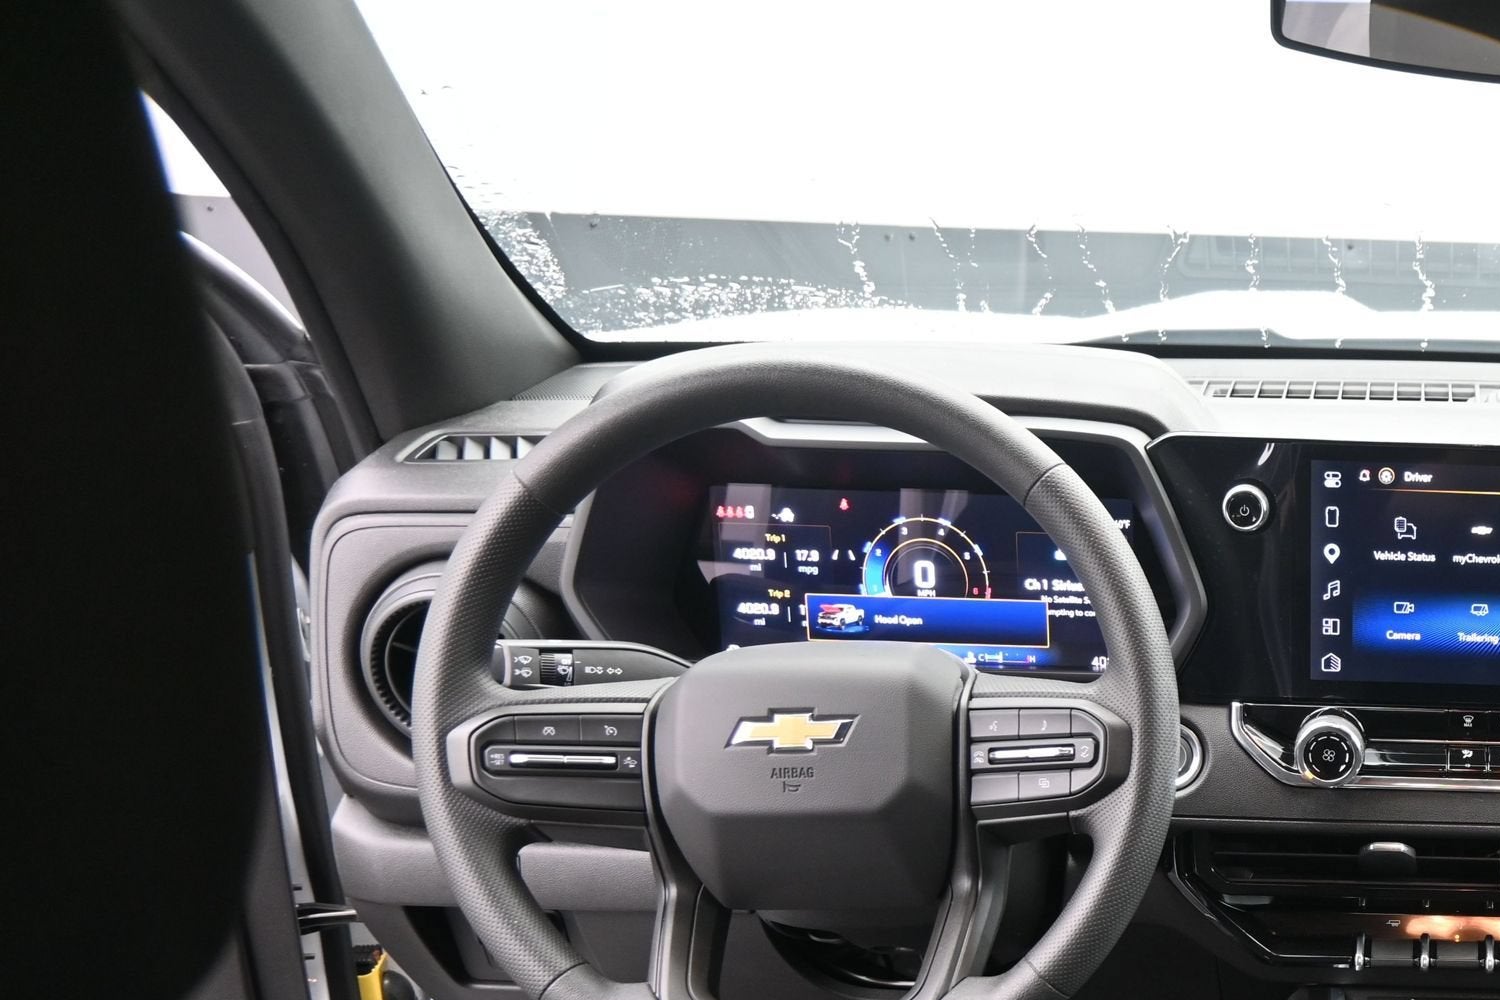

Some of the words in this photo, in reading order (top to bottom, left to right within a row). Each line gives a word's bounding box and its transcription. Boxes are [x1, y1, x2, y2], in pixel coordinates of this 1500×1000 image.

[1404, 471, 1433, 483] Driver
[902, 527, 908, 535] 3
[938, 528, 945, 536] 4
[765, 533, 781, 543] Trip
[1373, 550, 1406, 561] Vehicle
[1407, 551, 1436, 562] Status
[798, 566, 819, 575] mpg
[913, 560, 936, 589] 0
[768, 589, 784, 599] Trip
[917, 589, 936, 597] MPH
[1386, 630, 1421, 641] Camera
[1457, 632, 1500, 645] Trailering
[770, 766, 815, 779] AIRBAG
